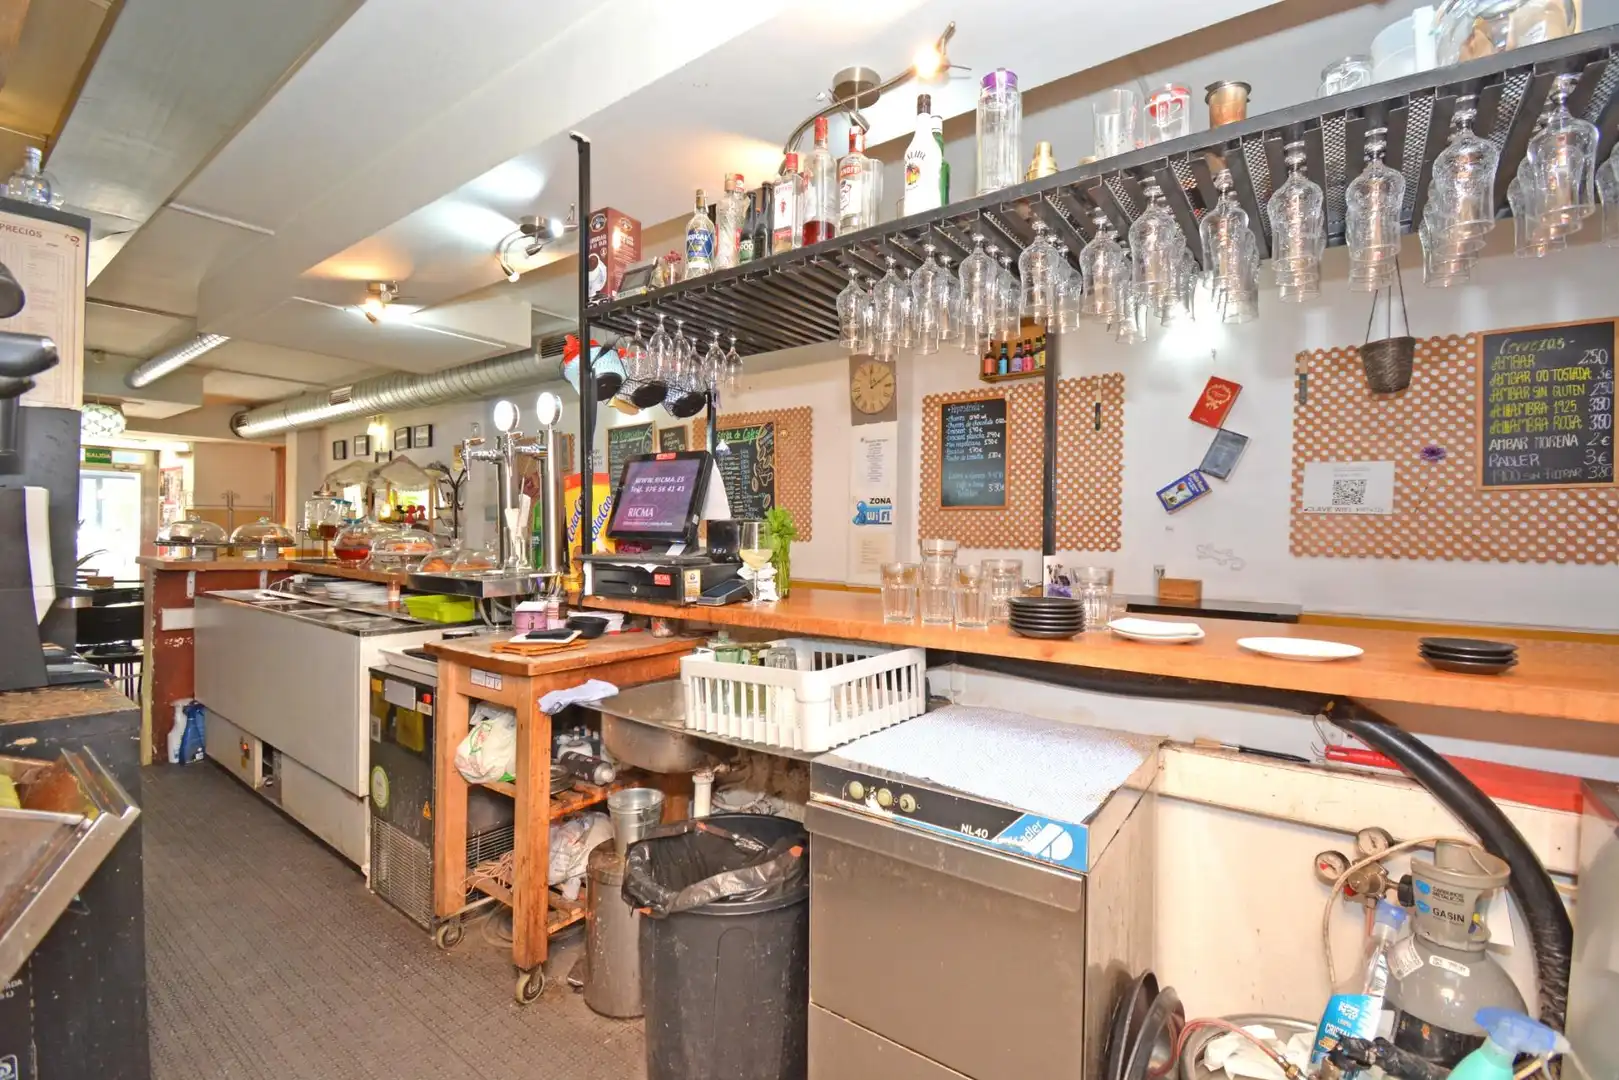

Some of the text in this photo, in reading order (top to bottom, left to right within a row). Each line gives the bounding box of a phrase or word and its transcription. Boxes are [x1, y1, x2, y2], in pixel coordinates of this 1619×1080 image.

[1499, 338, 1565, 355] Cervezas
[1491, 354, 1536, 371] AMBAR
[1490, 371, 1532, 386] AMBAR
[1490, 387, 1531, 402] AMBAR
[1552, 384, 1586, 398] GLUTEN
[1553, 400, 1577, 415] 1925
[1489, 436, 1529, 451] AMBAR
[1489, 453, 1540, 467] RADLER
[627, 507, 654, 517] RICMA
[960, 823, 989, 839] NL40
[1432, 907, 1465, 923] GASIN
